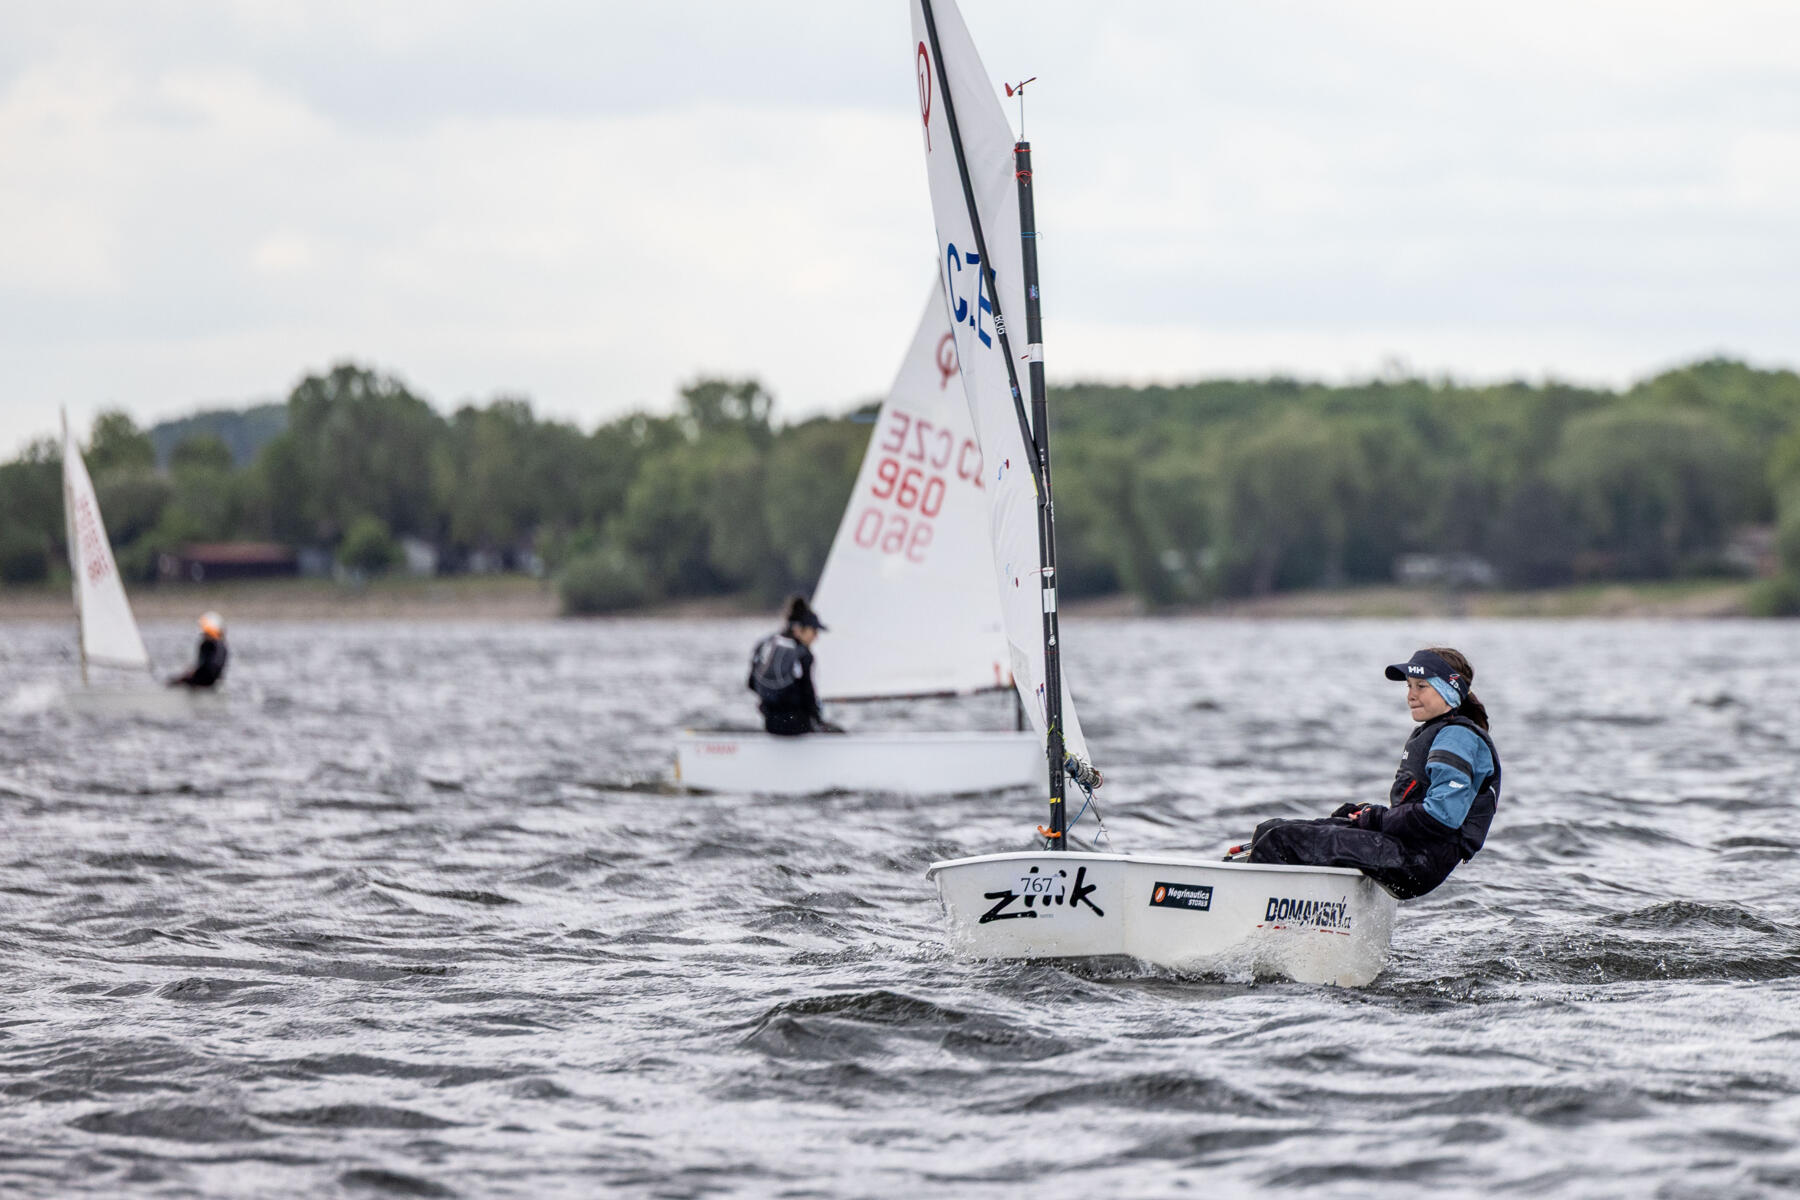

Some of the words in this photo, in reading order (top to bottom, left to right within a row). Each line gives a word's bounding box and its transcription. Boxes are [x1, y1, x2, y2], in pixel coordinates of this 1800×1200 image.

[871, 456, 946, 519] 960
[1020, 878, 1053, 893] 767
[1167, 887, 1210, 900] Negrinautica
